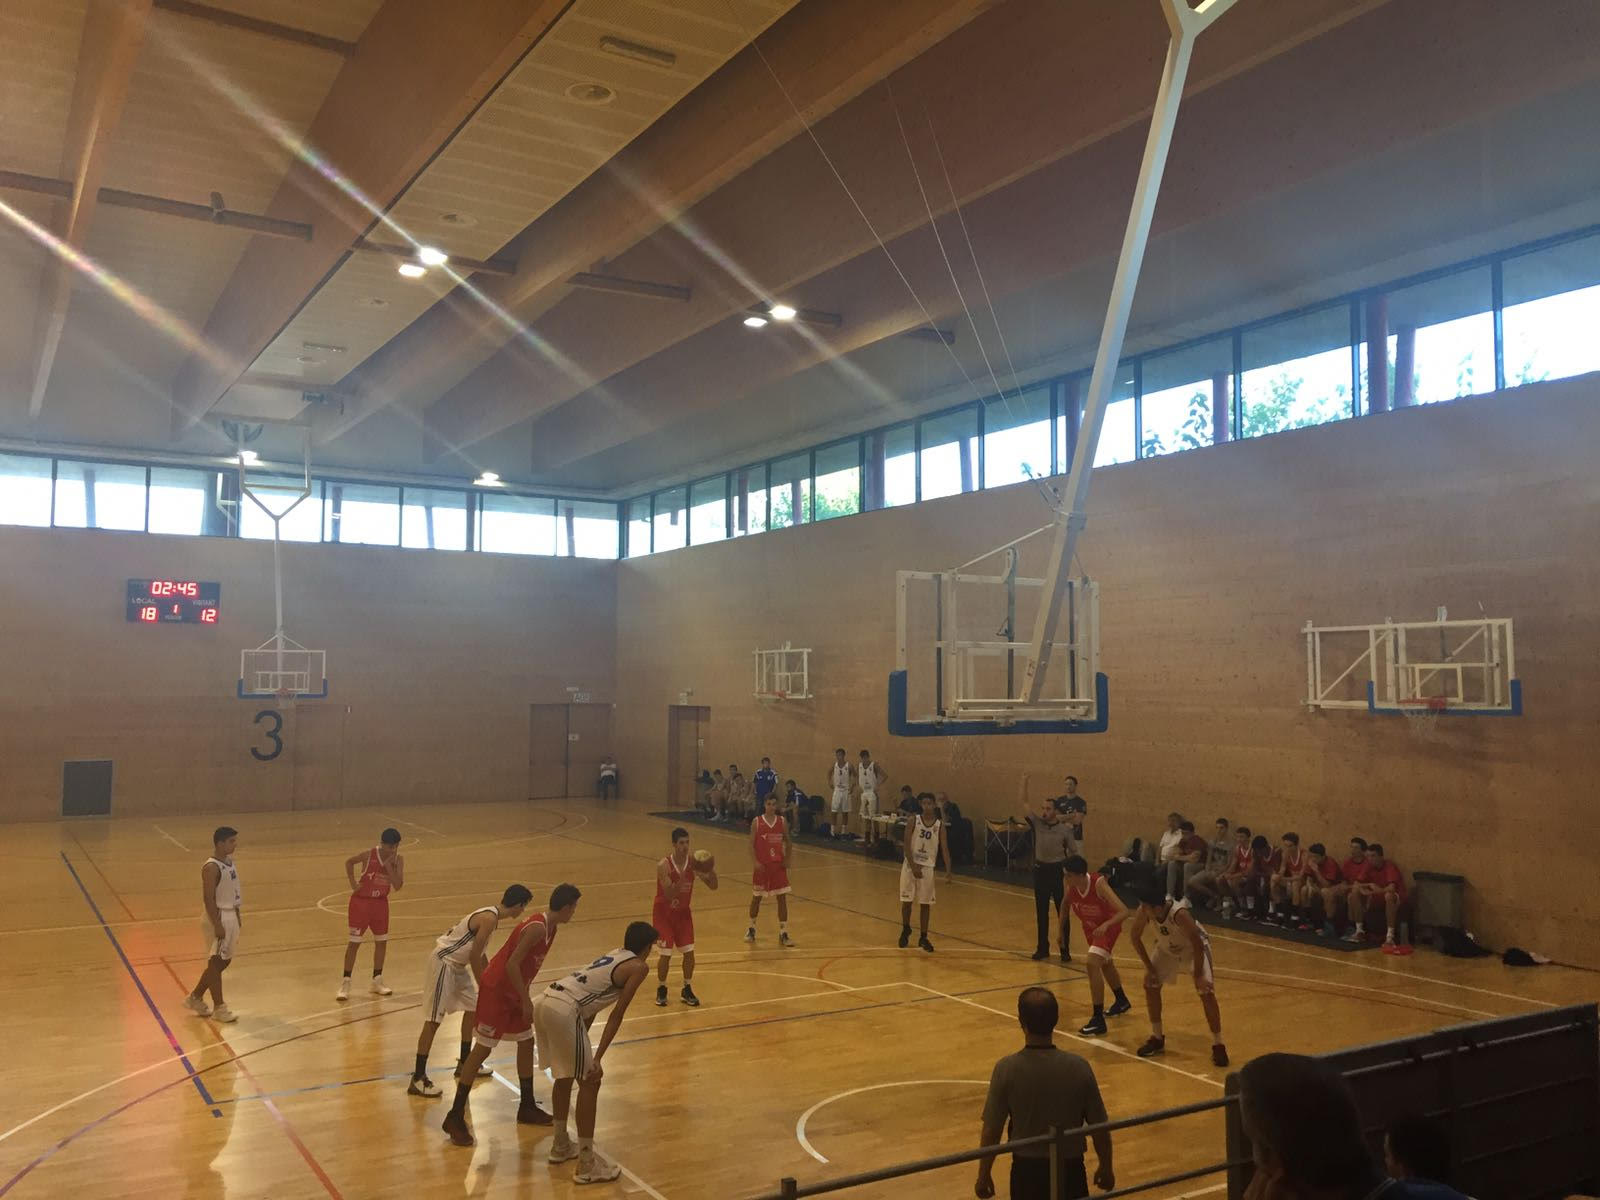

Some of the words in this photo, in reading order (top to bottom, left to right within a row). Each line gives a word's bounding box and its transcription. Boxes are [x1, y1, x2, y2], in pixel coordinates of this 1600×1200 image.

[151, 581, 197, 596] 02:45
[141, 607, 157, 621] 18
[201, 609, 217, 623] 12
[250, 710, 282, 761] 3
[919, 829, 932, 840] 30
